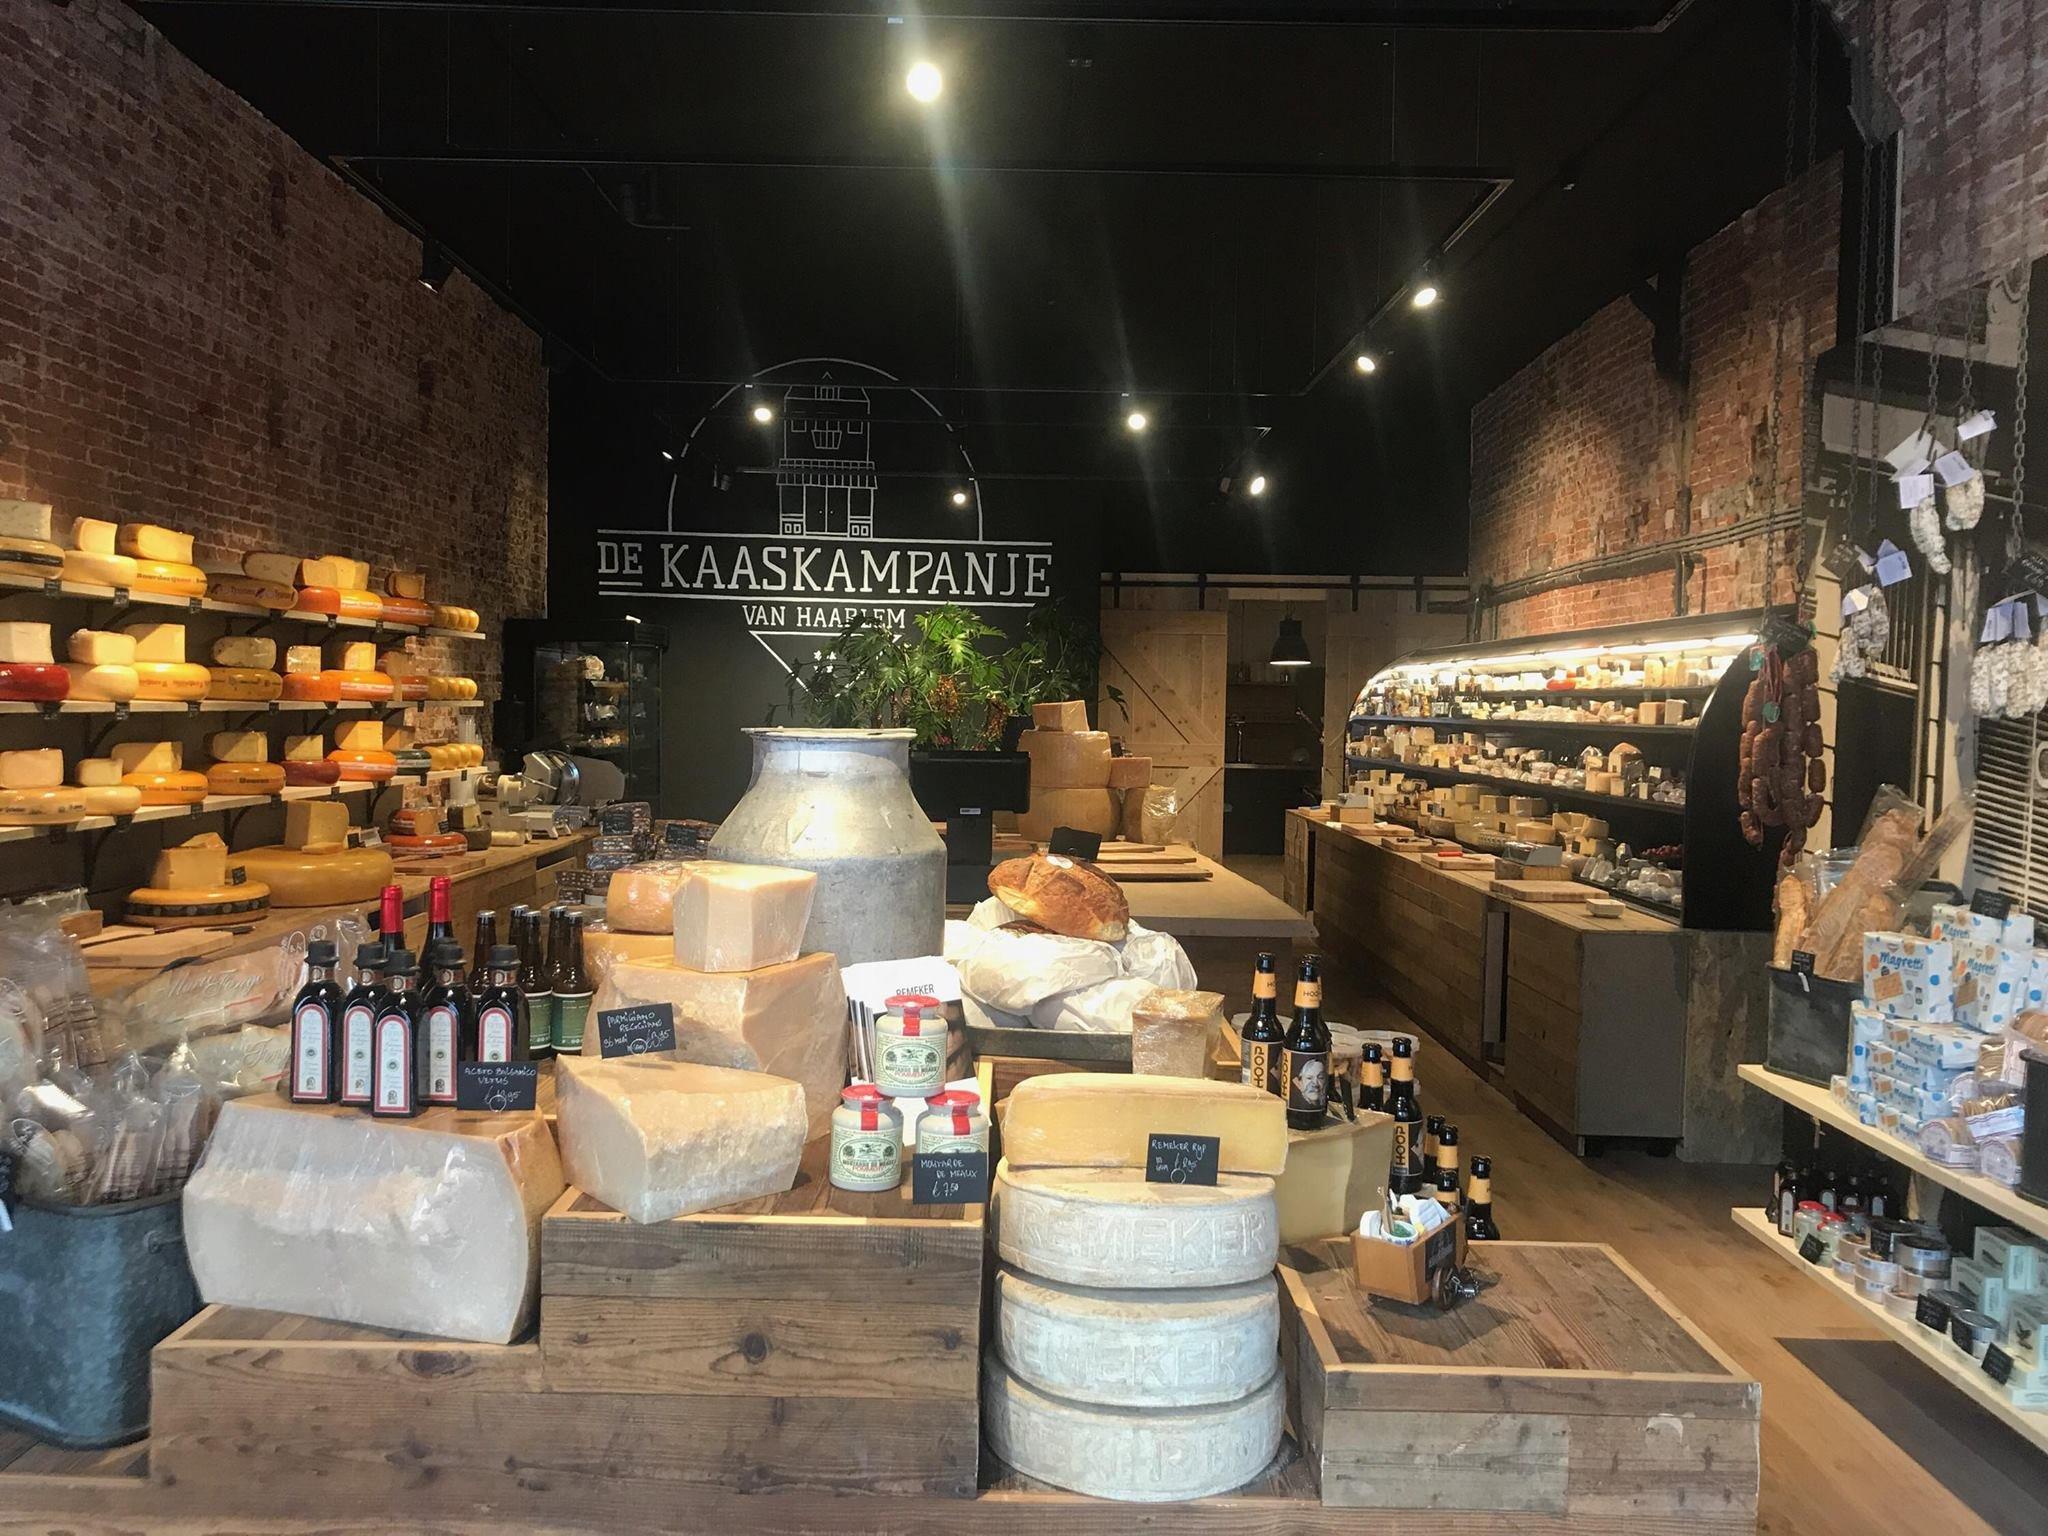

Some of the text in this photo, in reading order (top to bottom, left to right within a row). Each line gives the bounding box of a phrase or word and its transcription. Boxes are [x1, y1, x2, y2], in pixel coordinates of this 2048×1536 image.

[597, 541, 1052, 597] DE KAASKAMPANJE
[742, 604, 906, 629] VAN HAARLEM
[1879, 951, 1925, 971] Magretti
[895, 983, 935, 997] REMEKER
[1253, 1045, 1265, 1089] HOOP
[1281, 1051, 1289, 1097] HOOP
[1151, 1139, 1190, 1153] REMEKER
[1395, 1125, 1407, 1166] HOOP
[936, 1169, 978, 1179] DE MEAUX
[1021, 1201, 1269, 1266] REMEKER
